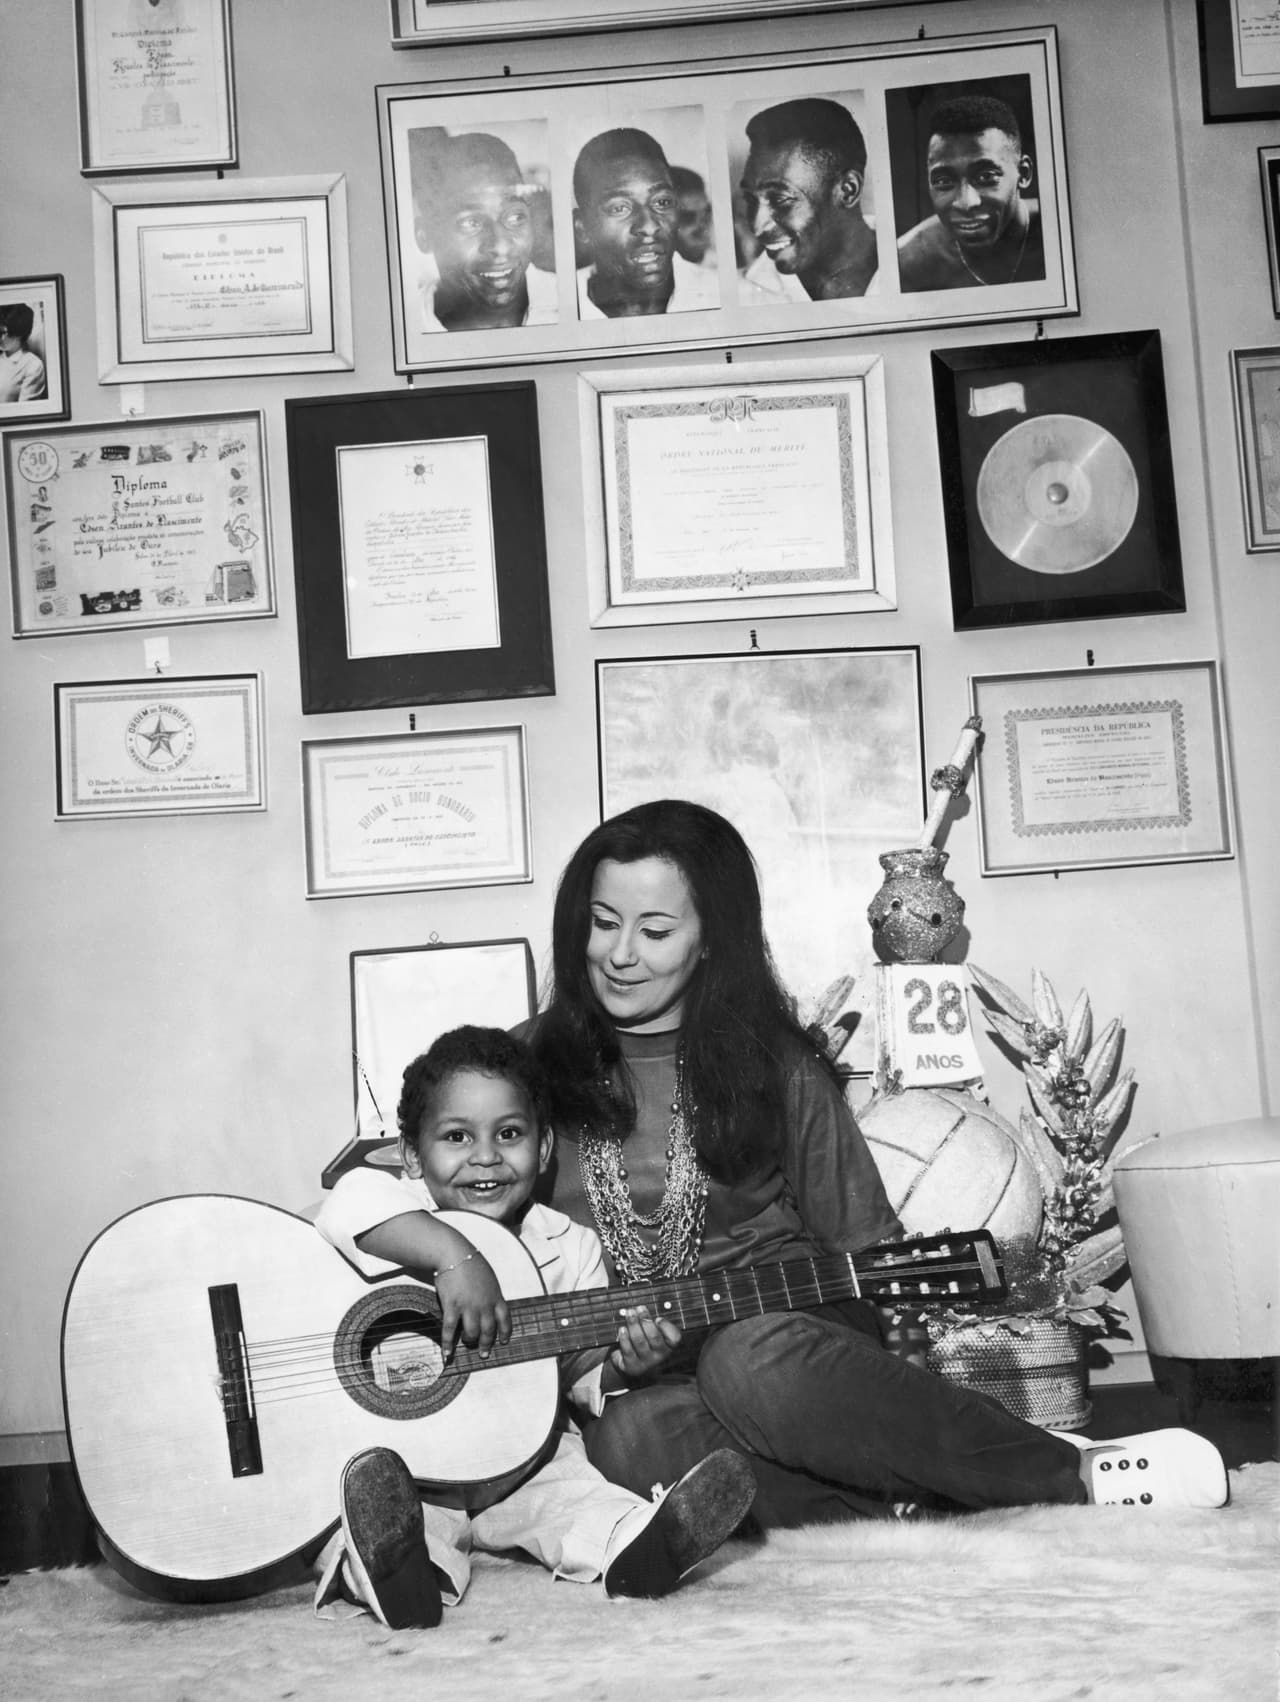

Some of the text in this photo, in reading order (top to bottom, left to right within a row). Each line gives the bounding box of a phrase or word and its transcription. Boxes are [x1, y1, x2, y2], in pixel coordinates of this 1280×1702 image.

[698, 447, 746, 457] NATIONAL
[111, 475, 168, 498] Diploma
[123, 497, 149, 512] Santos
[80, 522, 104, 534] Edson
[157, 513, 203, 528] Nascimento
[128, 708, 149, 734] ORDEM
[158, 704, 192, 729] SHERIFFS
[358, 803, 388, 830] DIPLOMA
[904, 978, 967, 1035] 28
[916, 1054, 964, 1070] ANOS
